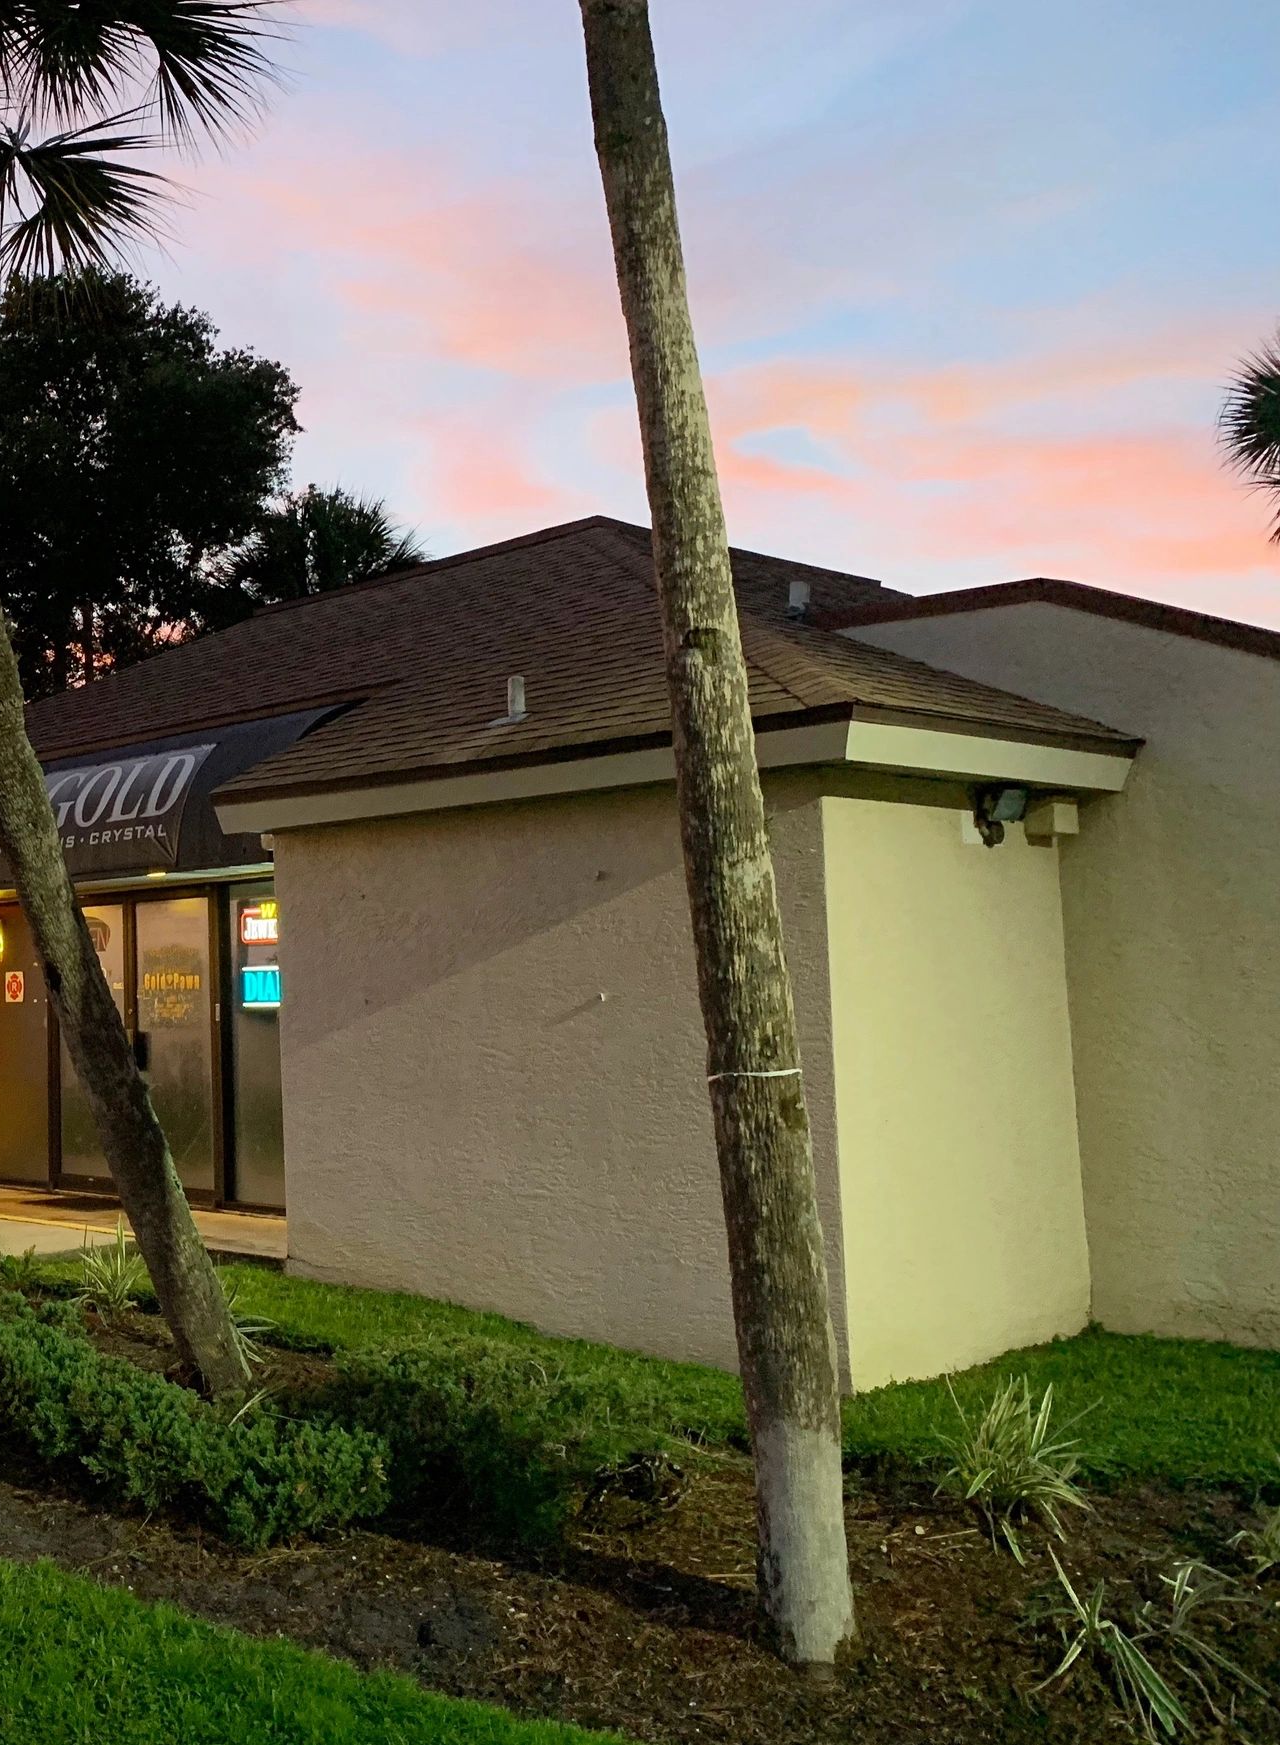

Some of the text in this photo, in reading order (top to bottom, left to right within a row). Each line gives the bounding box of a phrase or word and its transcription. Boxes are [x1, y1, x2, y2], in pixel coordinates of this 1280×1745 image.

[48, 753, 196, 828] GOLD
[89, 823, 167, 845] CRYSTAL
[244, 971, 280, 1002] DIA
